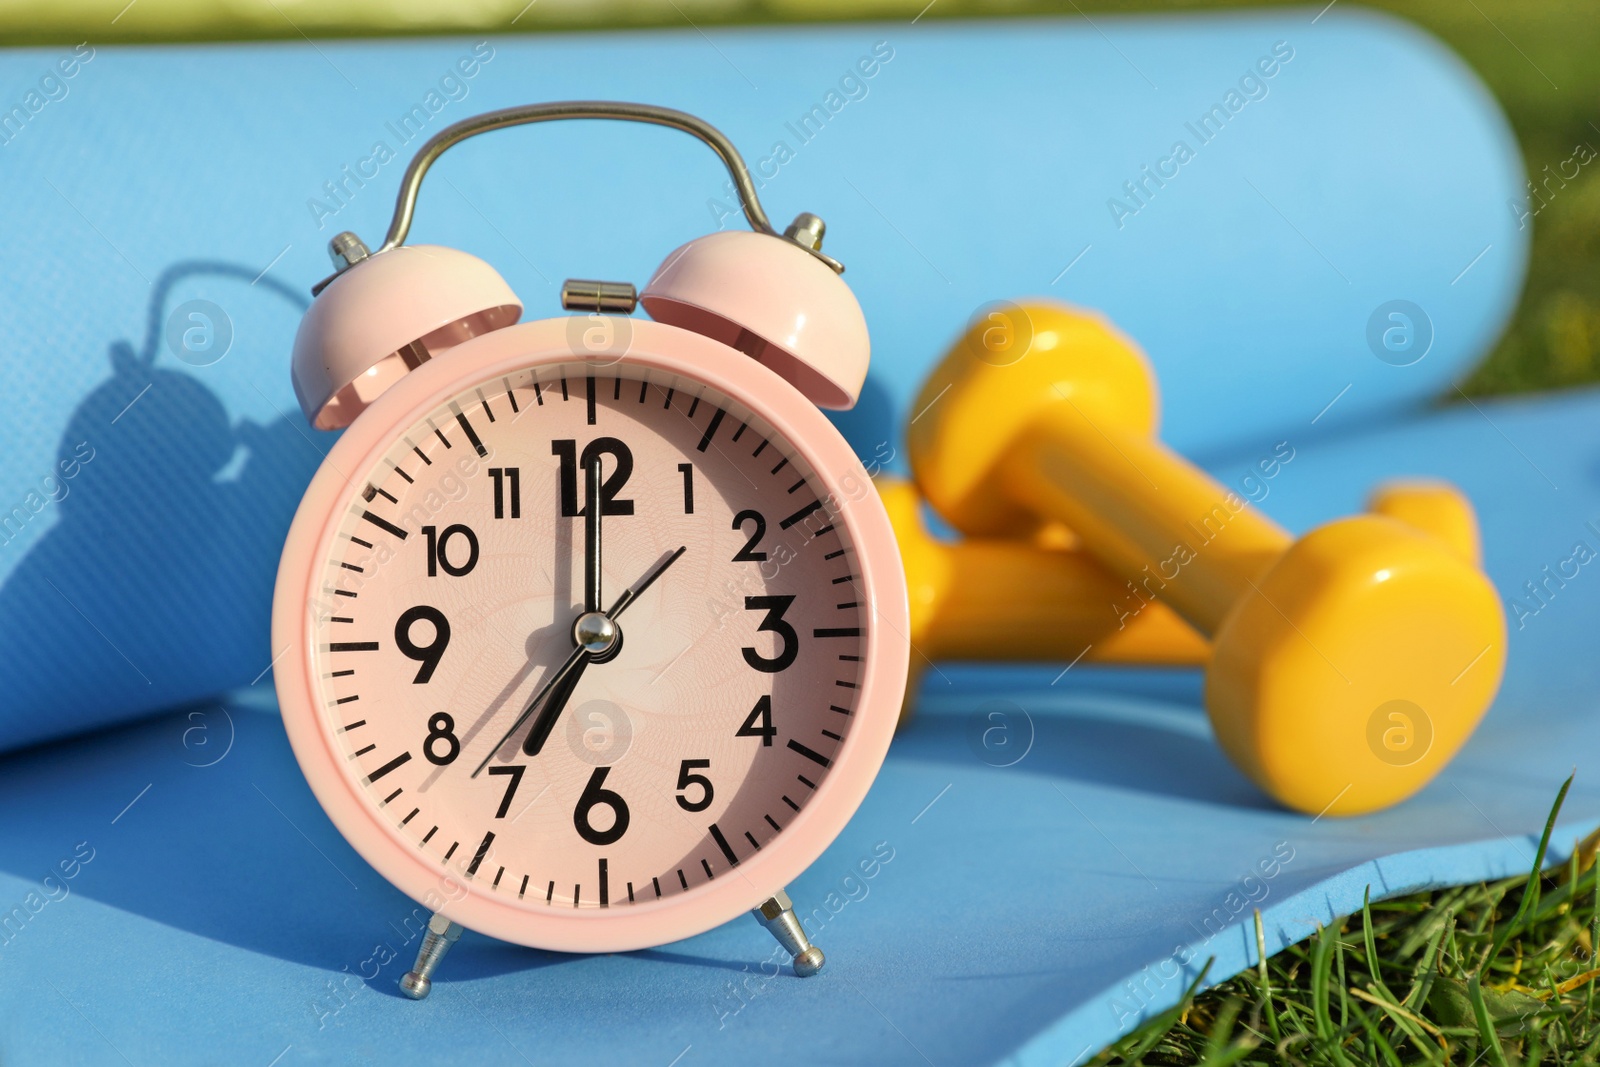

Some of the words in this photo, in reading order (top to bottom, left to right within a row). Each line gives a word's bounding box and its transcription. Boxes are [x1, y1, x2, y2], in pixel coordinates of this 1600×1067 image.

[489, 468, 520, 519] 11
[552, 437, 634, 517] 12
[678, 464, 694, 513] 1
[422, 524, 479, 577] 10
[732, 510, 767, 562] 2
[395, 606, 450, 684] 9
[742, 595, 799, 673] 3
[424, 712, 460, 765] 8
[736, 695, 777, 747] 4
[489, 766, 527, 819] 7
[574, 767, 630, 846] 6
[676, 759, 714, 813] 5
